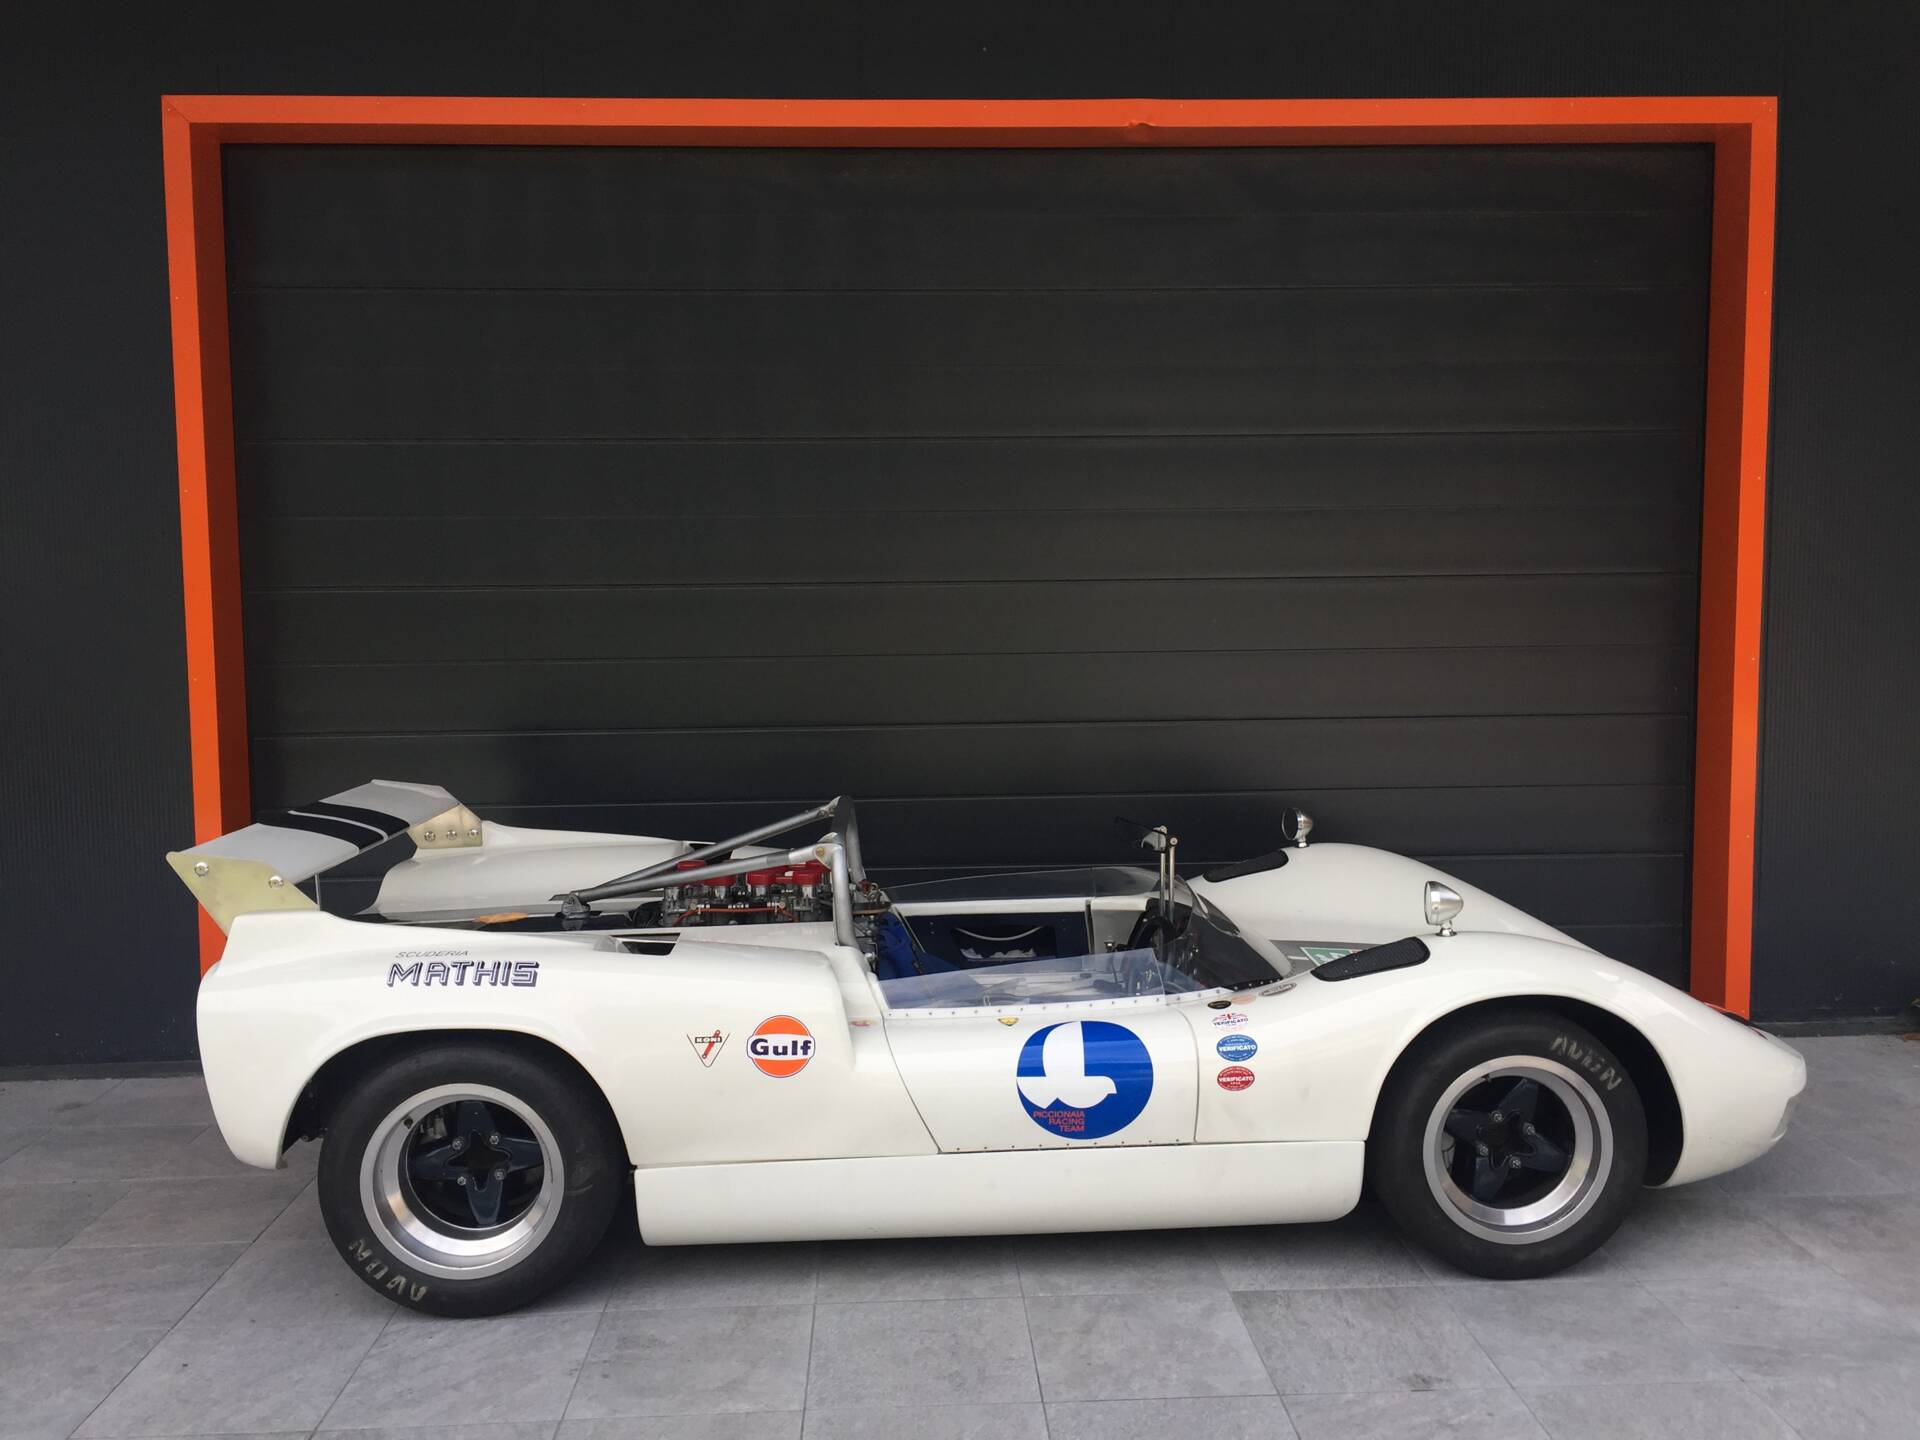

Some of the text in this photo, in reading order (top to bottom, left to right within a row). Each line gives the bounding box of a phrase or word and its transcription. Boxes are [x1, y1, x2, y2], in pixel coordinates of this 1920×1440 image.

[395, 950, 469, 958] SCUDERIA
[387, 960, 540, 987] MATHIS
[750, 1038, 812, 1056] Gulf
[1218, 1044, 1257, 1052] VERIFICATO
[1033, 1110, 1085, 1118] PICCIONAIA
